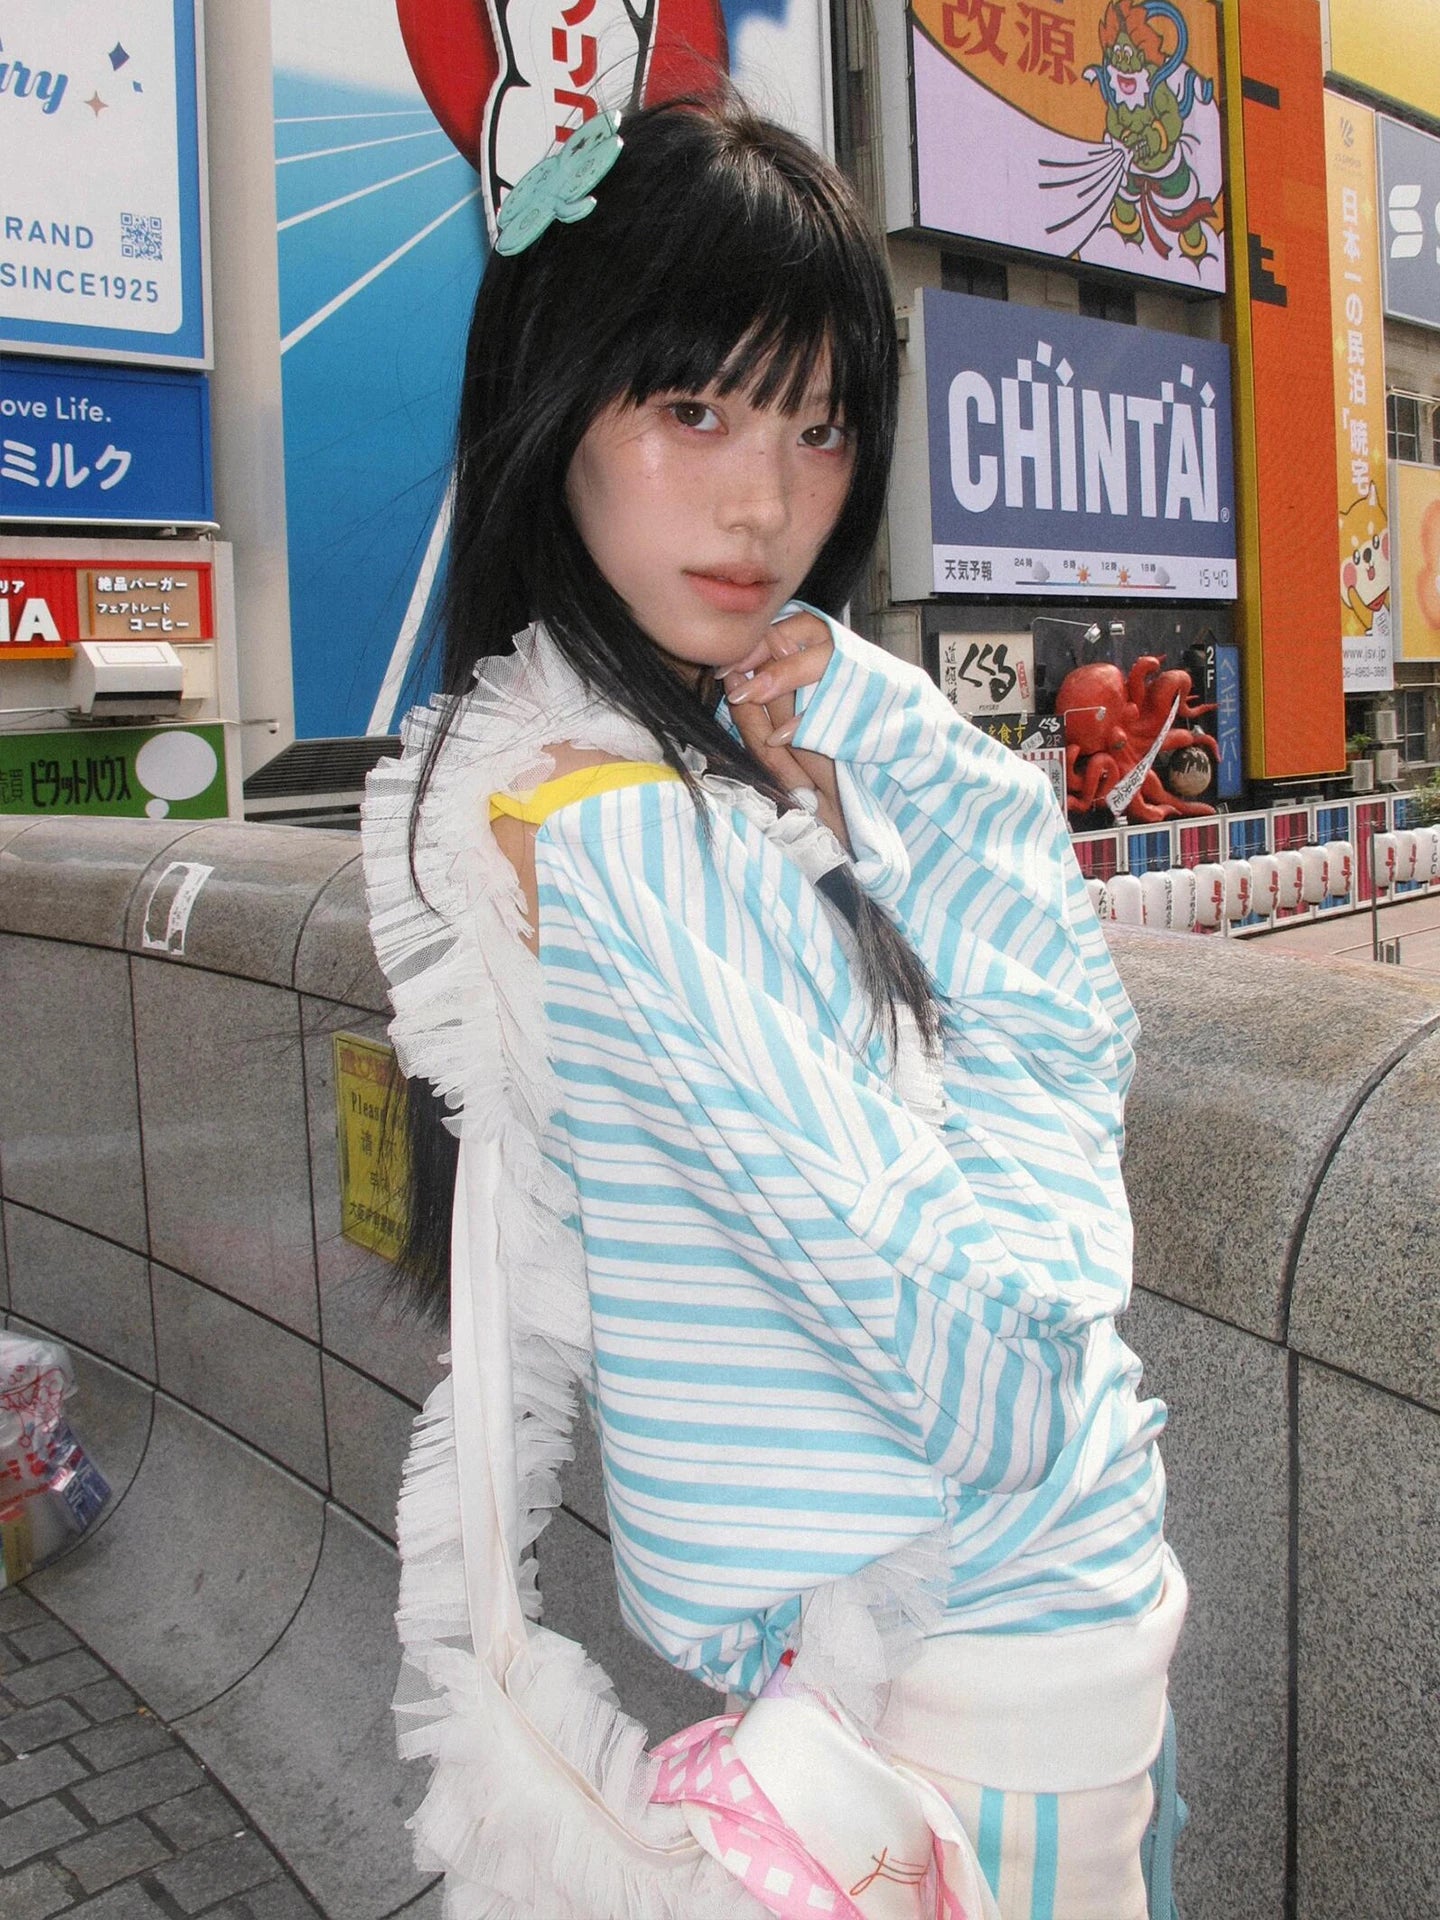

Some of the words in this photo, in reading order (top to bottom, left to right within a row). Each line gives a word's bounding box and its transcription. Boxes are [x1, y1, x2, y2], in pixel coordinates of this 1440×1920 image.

[56, 397, 112, 423] Life.
[948, 341, 1219, 523] CHINTAI
[1, 438, 132, 491] ミルク
[944, 559, 992, 581] 天気予報
[97, 576, 188, 592] 絶品バーガー
[130, 617, 189, 632] コーヒー
[958, 643, 1017, 703] くくる
[1046, 734, 1062, 747] 2F
[30, 755, 132, 807] ピタットハウス
